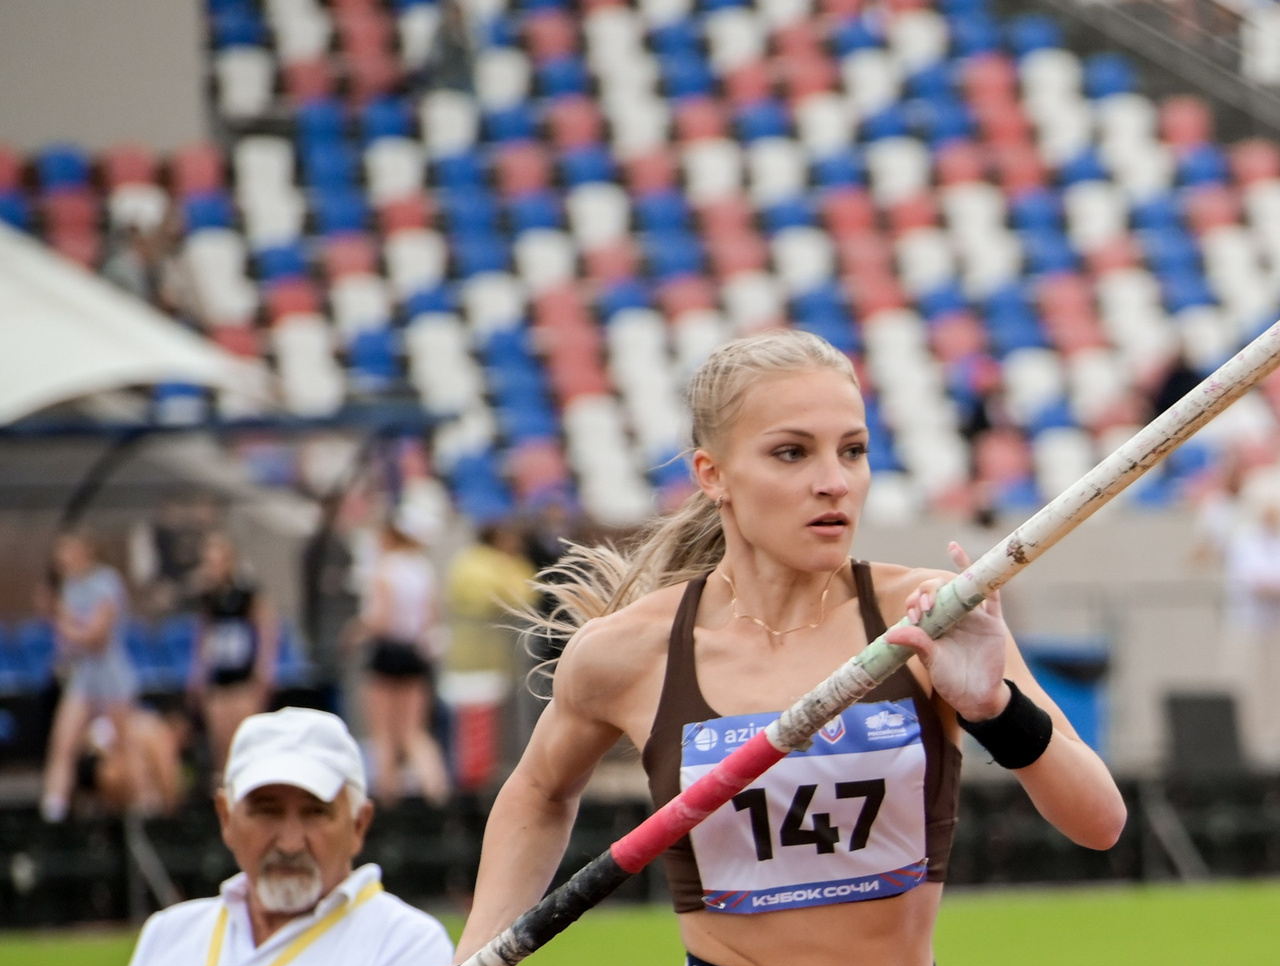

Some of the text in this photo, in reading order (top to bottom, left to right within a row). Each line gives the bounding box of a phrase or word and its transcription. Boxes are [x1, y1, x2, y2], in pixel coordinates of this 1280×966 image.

[731, 778, 885, 861] 147
[752, 880, 880, 907] КУБОК СОЧИ
